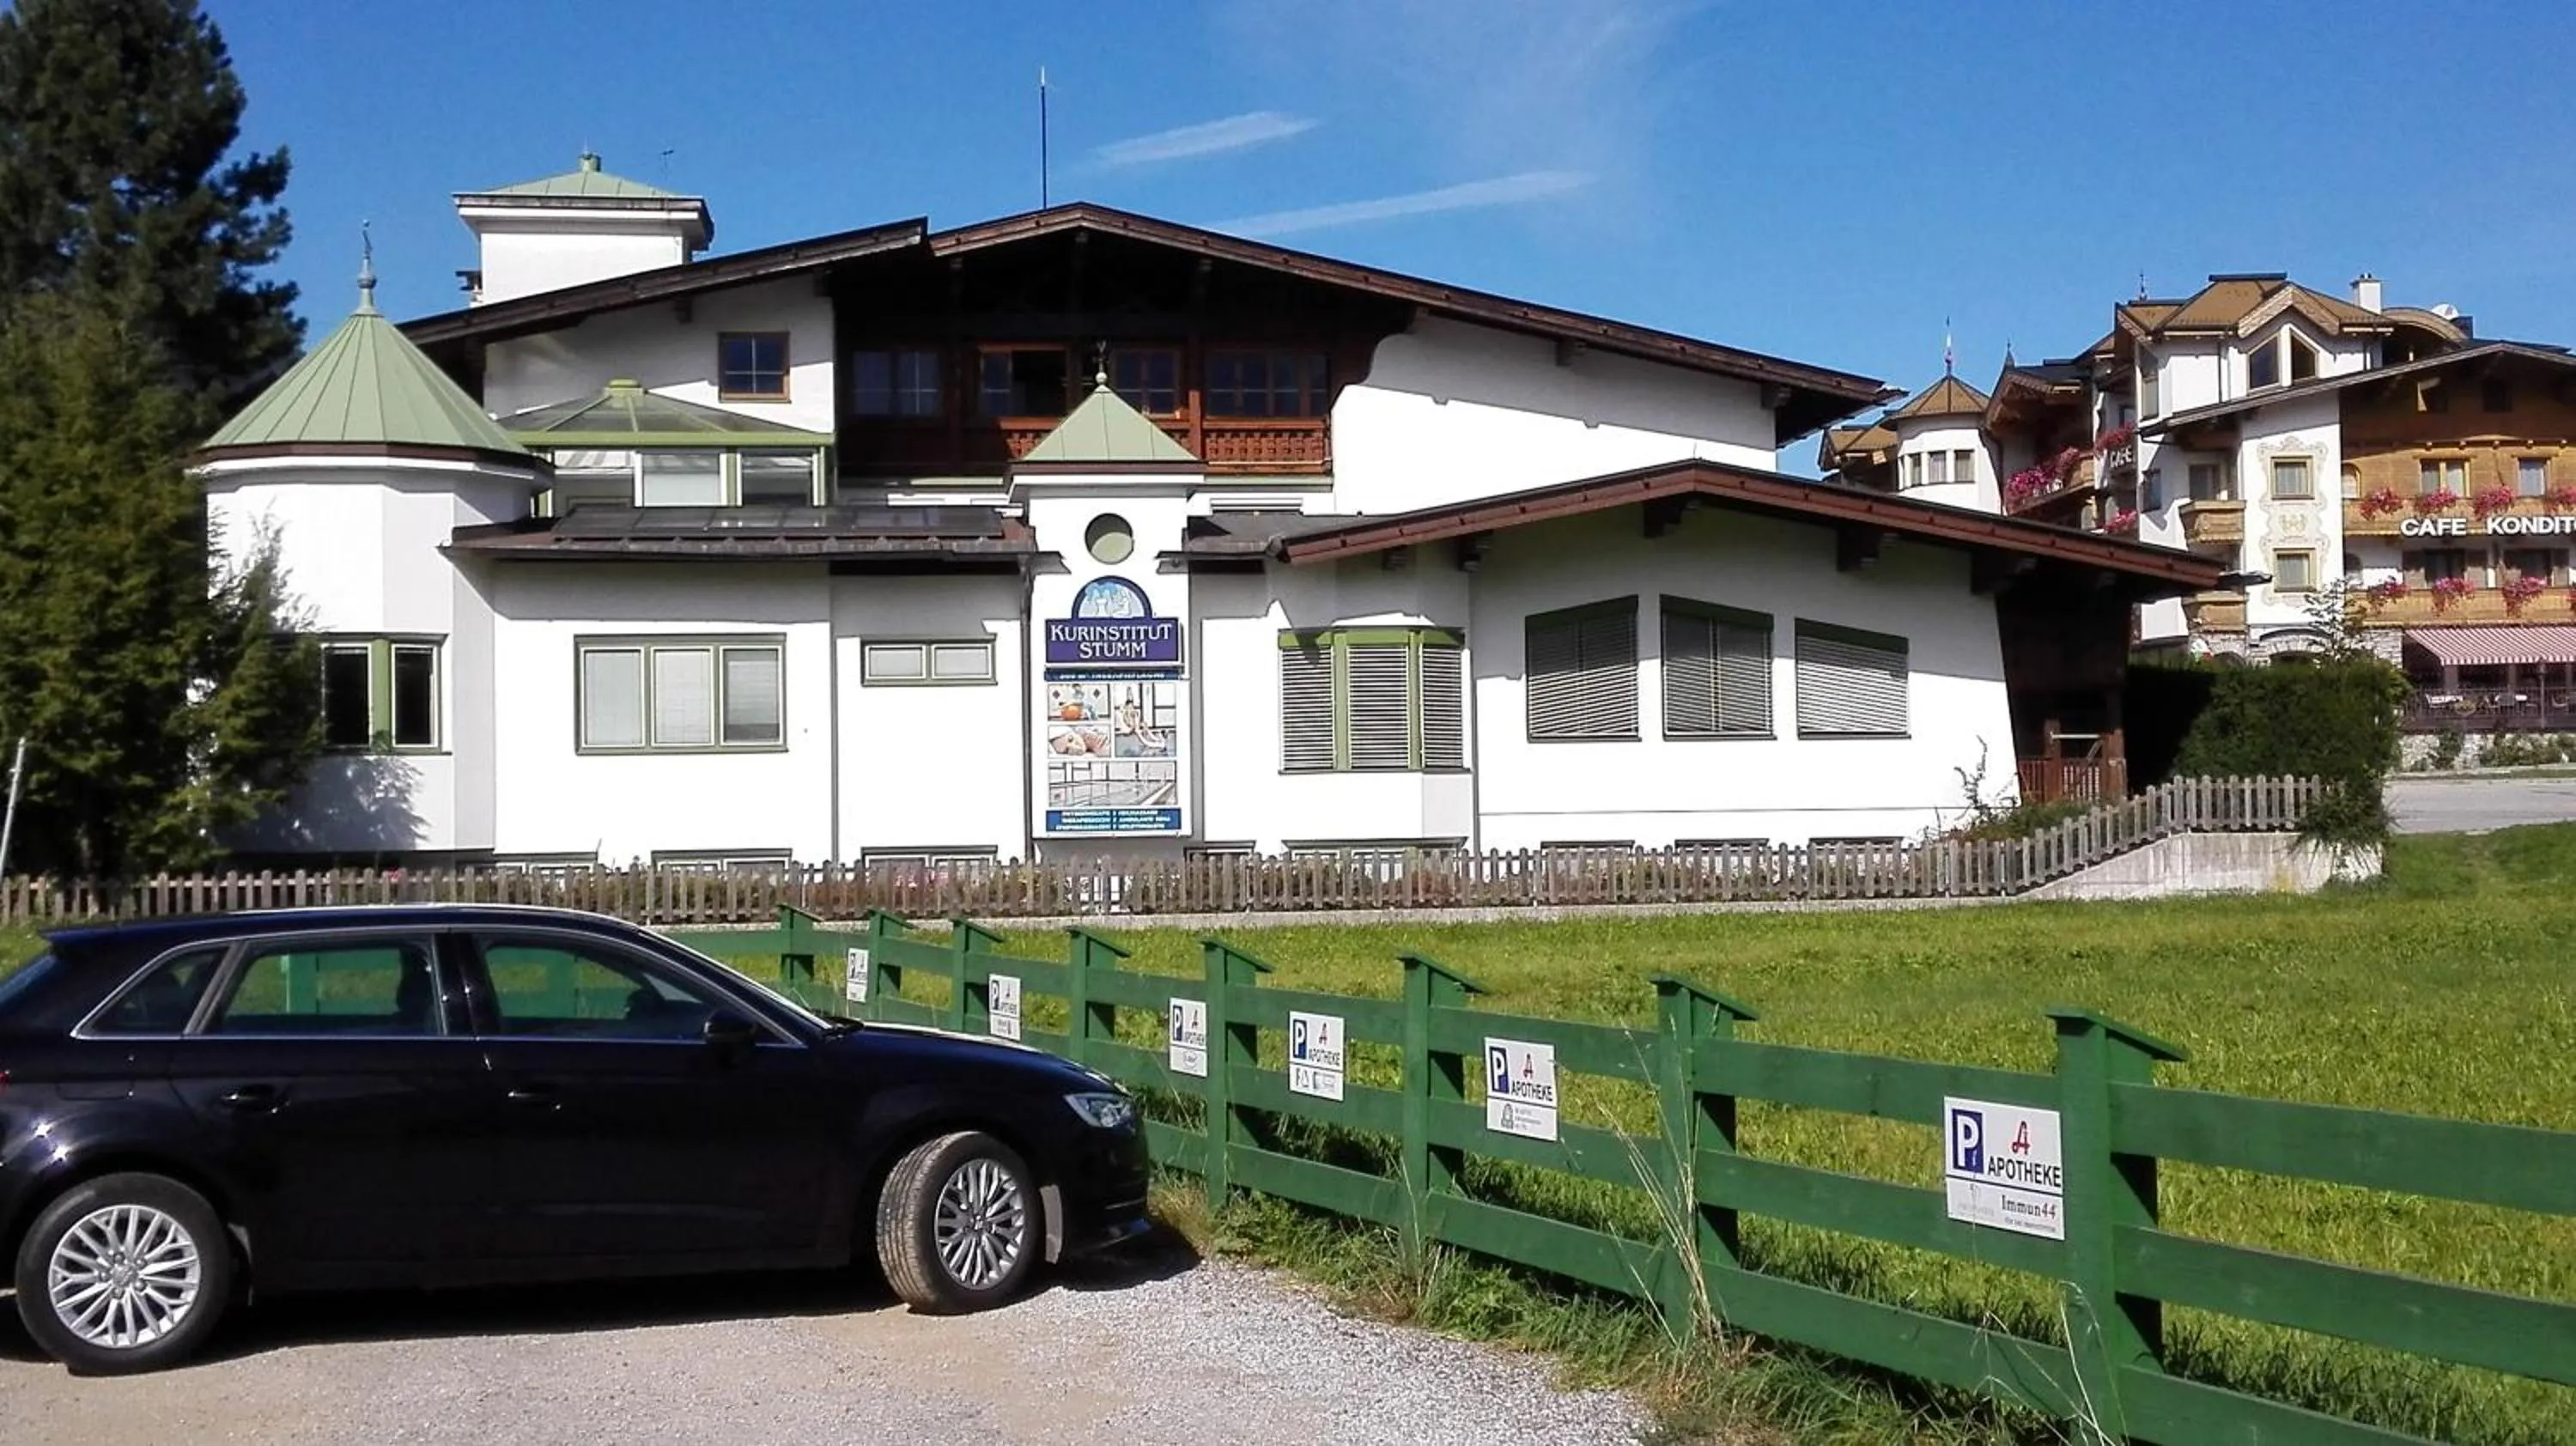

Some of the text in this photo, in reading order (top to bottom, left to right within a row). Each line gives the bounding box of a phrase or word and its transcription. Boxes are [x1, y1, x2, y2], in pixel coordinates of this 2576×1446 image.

[2400, 516, 2576, 537] CAFE KONDIT
[1050, 623, 1173, 641] KURINSTITUT
[1078, 641, 1147, 659] STUMM
[1174, 1007, 1182, 1040] P
[1294, 1021, 1305, 1056] P
[1492, 1049, 1506, 1090] P
[1510, 1079, 1553, 1102] APOTHEKE
[1956, 1114, 1980, 1167] P
[1987, 1156, 2061, 1188] APOTHEKE
